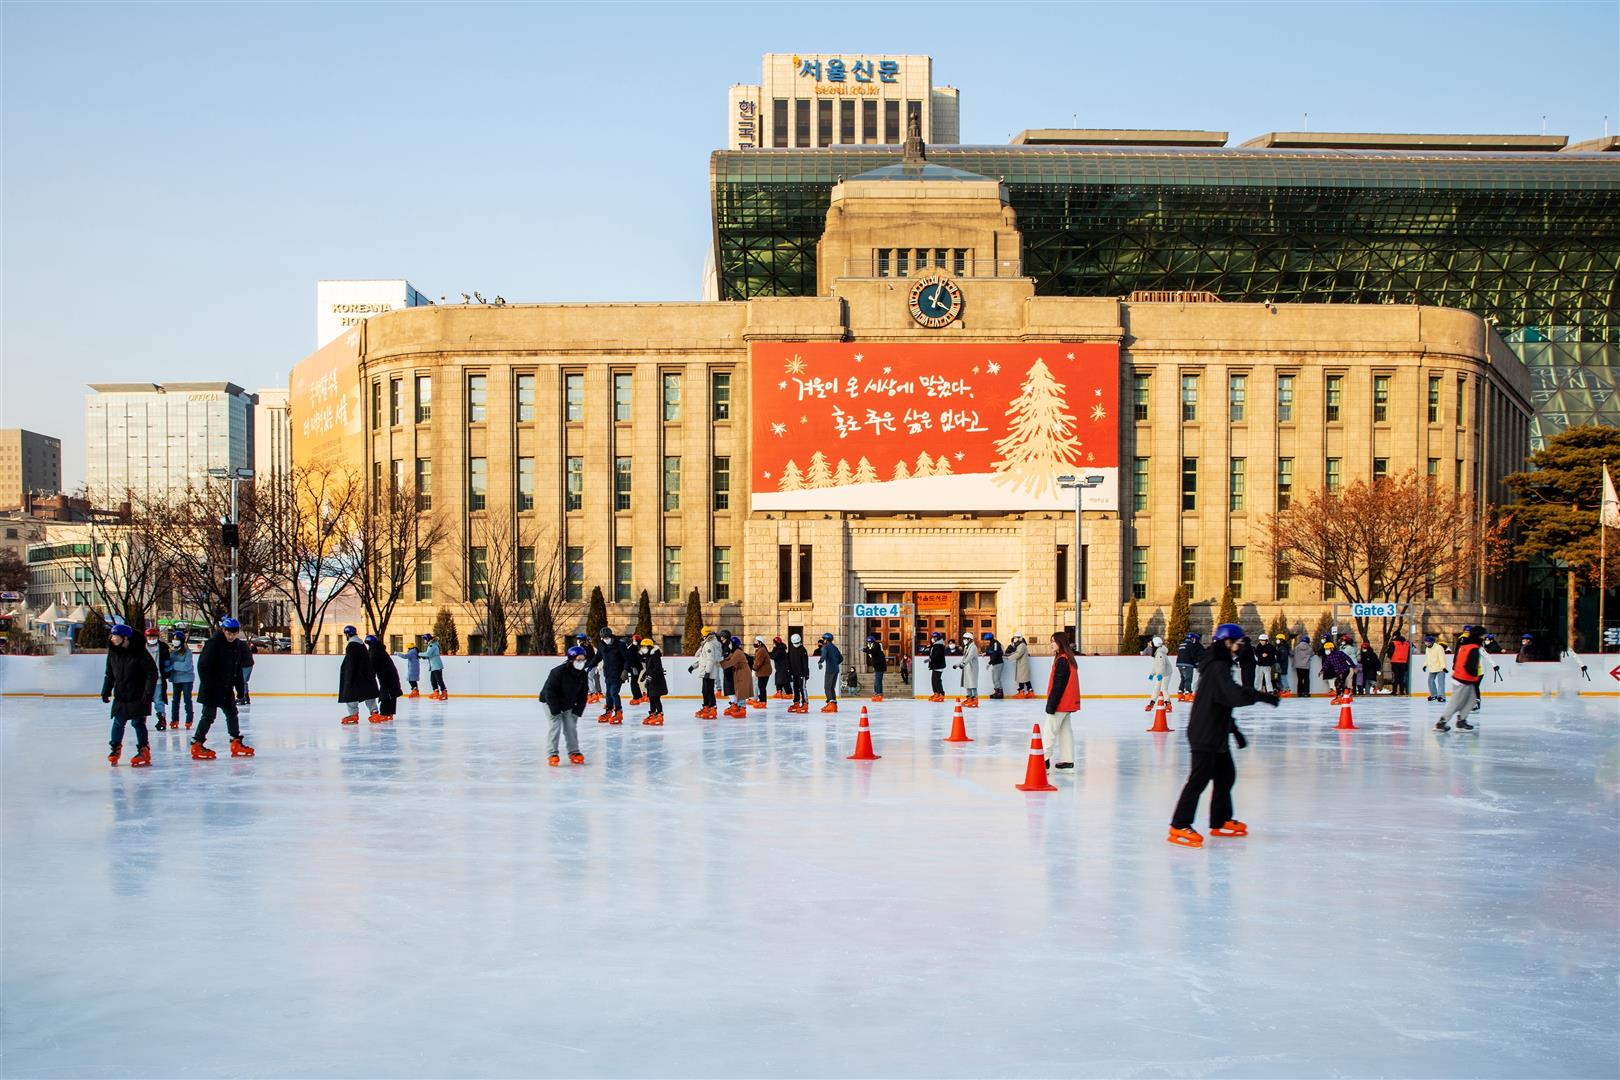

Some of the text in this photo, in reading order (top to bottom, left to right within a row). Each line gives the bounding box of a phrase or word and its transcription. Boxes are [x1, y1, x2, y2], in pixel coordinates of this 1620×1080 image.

[800, 58, 898, 82] 서울신문
[815, 84, 880, 95] seoul.co.kr
[332, 304, 392, 313] KOREANA
[792, 377, 838, 400] 겨울이
[846, 376, 859, 398] 온
[864, 378, 914, 397] 세상에
[832, 405, 989, 439] 홀로 추운 삶은 없다고
[856, 605, 898, 616] Gate 4
[1354, 604, 1394, 615] Gate 3
